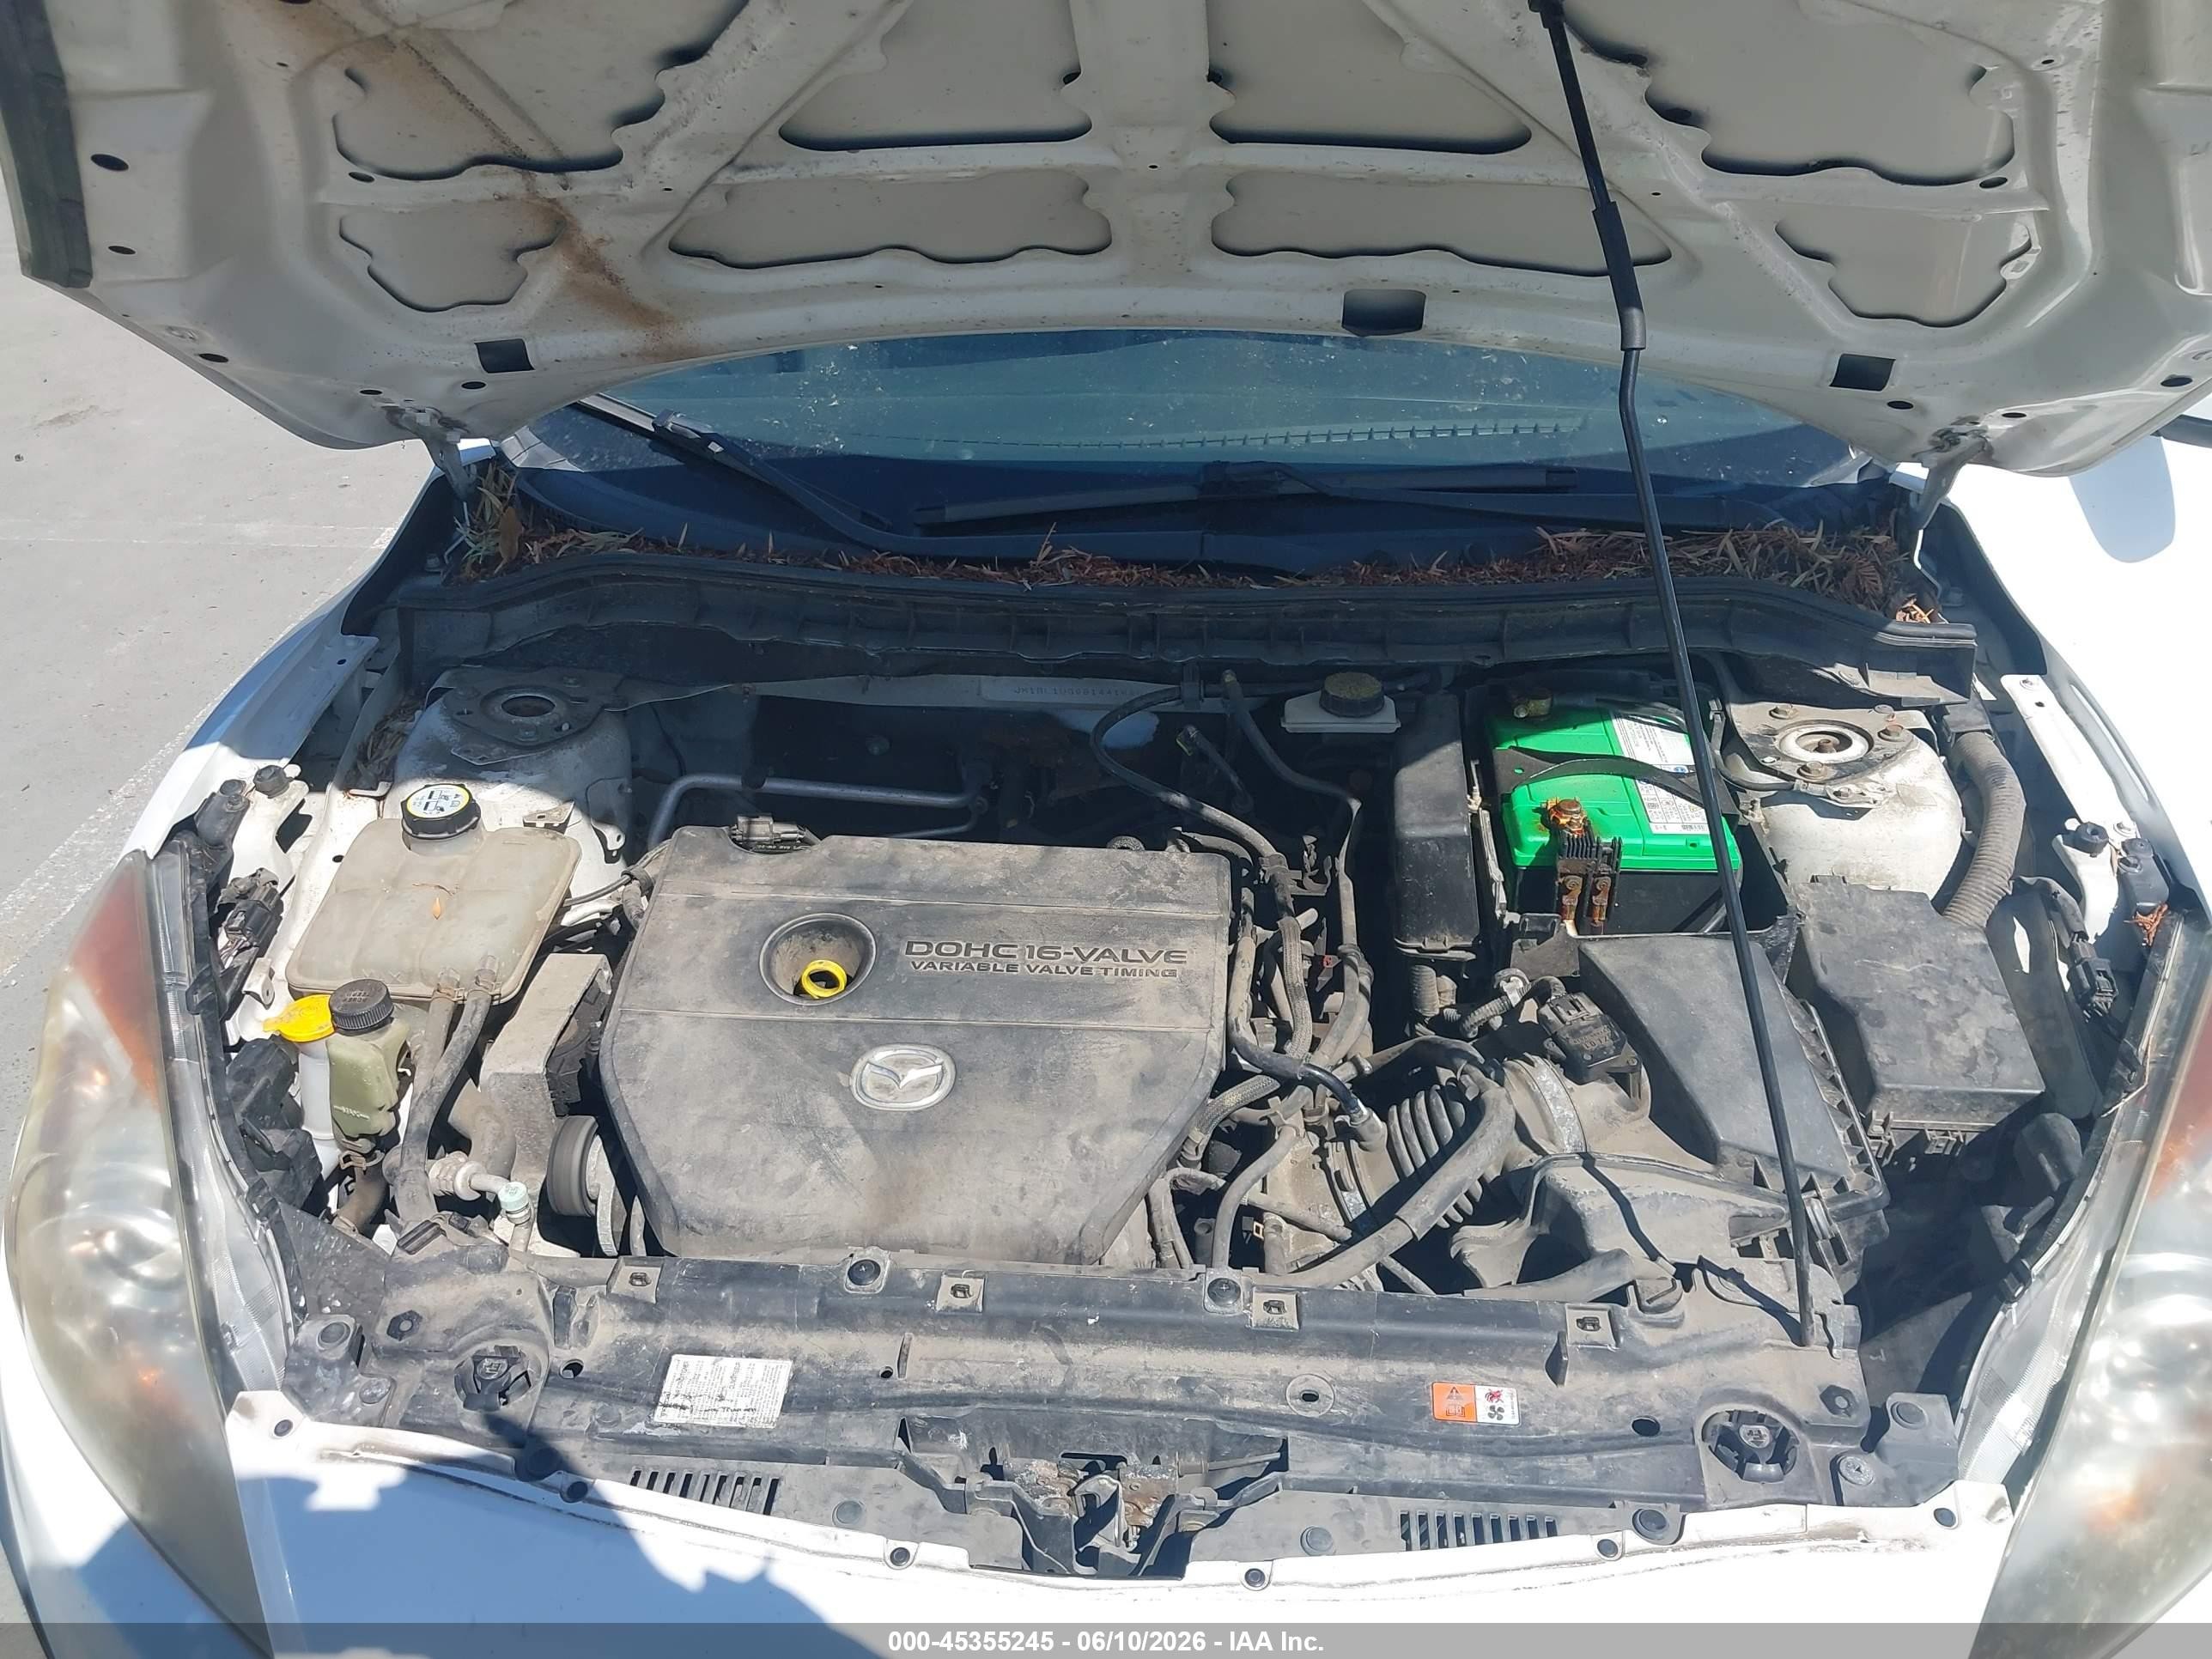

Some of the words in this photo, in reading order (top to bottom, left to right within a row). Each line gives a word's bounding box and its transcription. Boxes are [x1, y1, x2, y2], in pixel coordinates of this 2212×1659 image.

[904, 940, 1018, 959] DOHC
[1025, 944, 1188, 964] 16-VALVE
[910, 960, 1019, 973] VARIABLE
[1026, 963, 1094, 976] VALVE
[1099, 967, 1177, 978] TIMING
